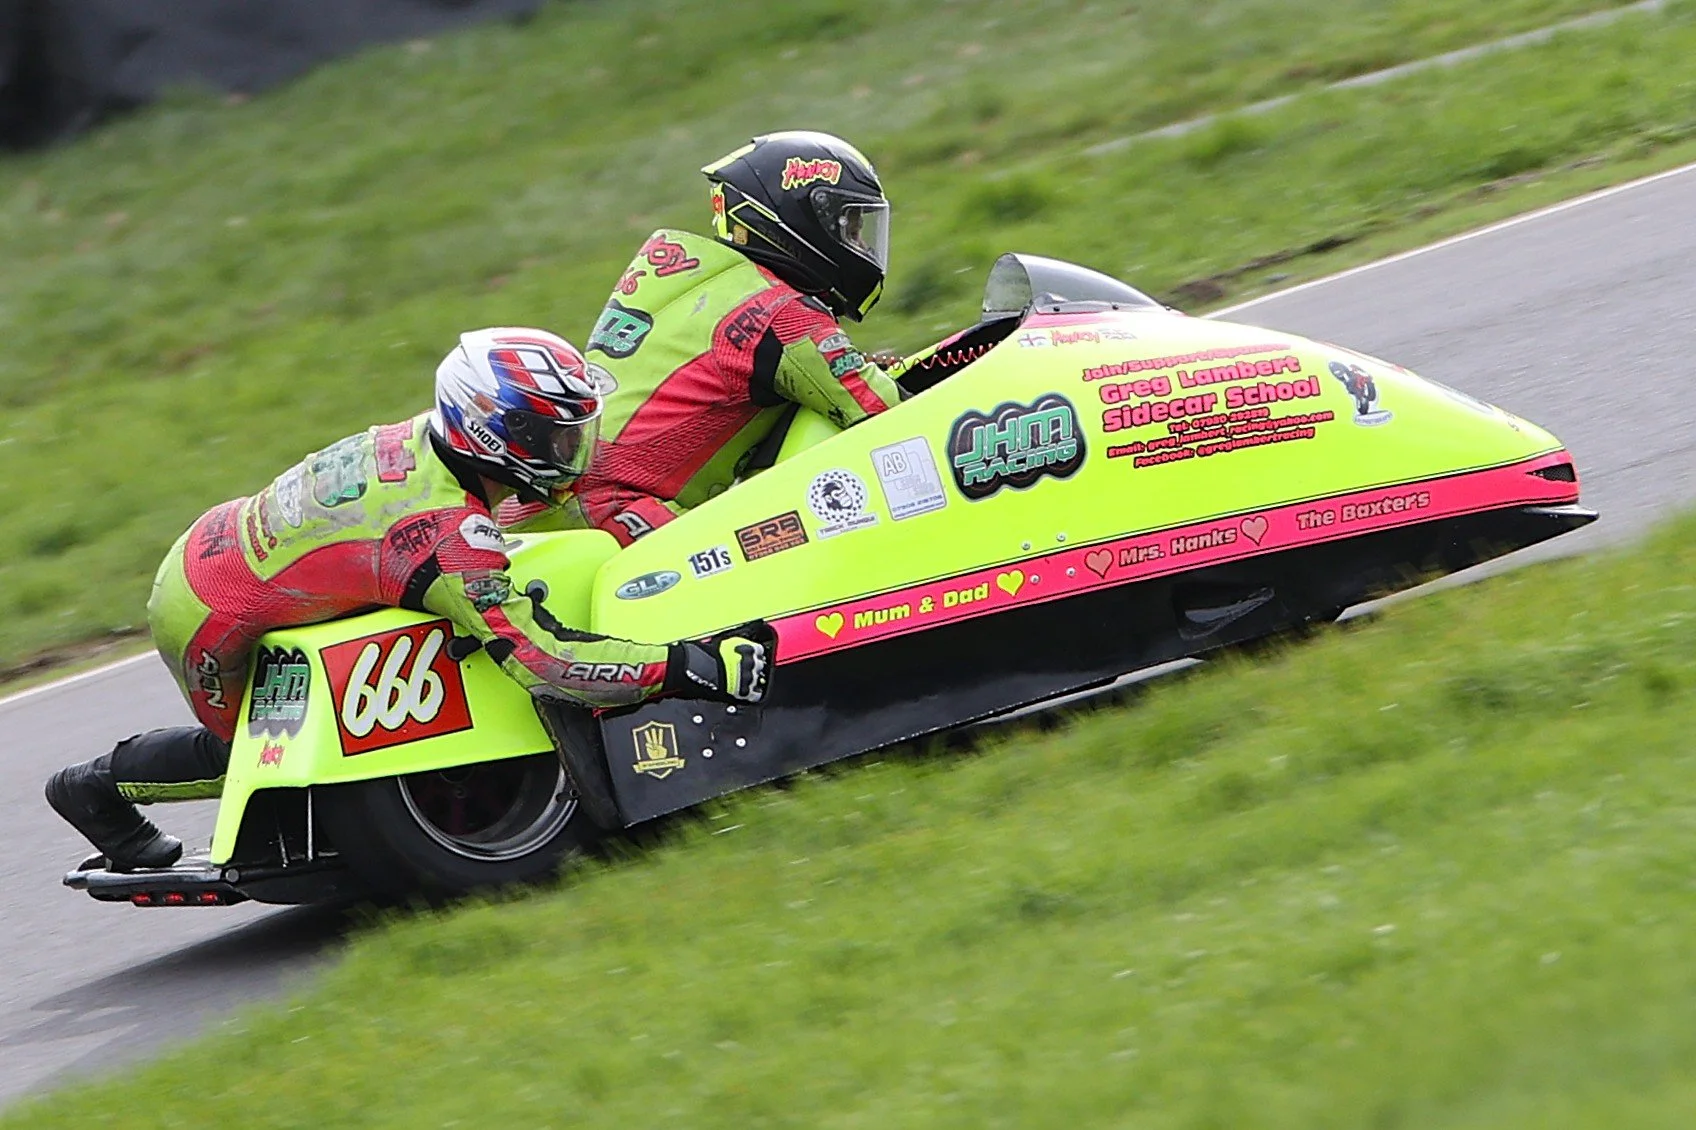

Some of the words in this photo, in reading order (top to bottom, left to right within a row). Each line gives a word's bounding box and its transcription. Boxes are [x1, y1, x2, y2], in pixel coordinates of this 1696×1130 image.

[1100, 374, 1171, 404] Greg
[1177, 355, 1301, 388] Lambert
[1102, 392, 1218, 432] Sidecar
[1224, 376, 1321, 408] School
[466, 421, 503, 453] SHOEI
[954, 405, 1073, 468] JHM
[882, 451, 907, 477] AB
[963, 439, 1077, 486] RACING
[1297, 509, 1335, 530] The
[1341, 491, 1431, 522] Baxters
[1118, 544, 1165, 567] Mrs.
[1170, 527, 1237, 556] Hanks
[853, 603, 911, 630] Mum
[918, 596, 935, 614] &
[943, 582, 990, 608] Dad
[197, 648, 228, 709] ARN
[341, 627, 446, 740] 666
[564, 662, 646, 683] ARN
